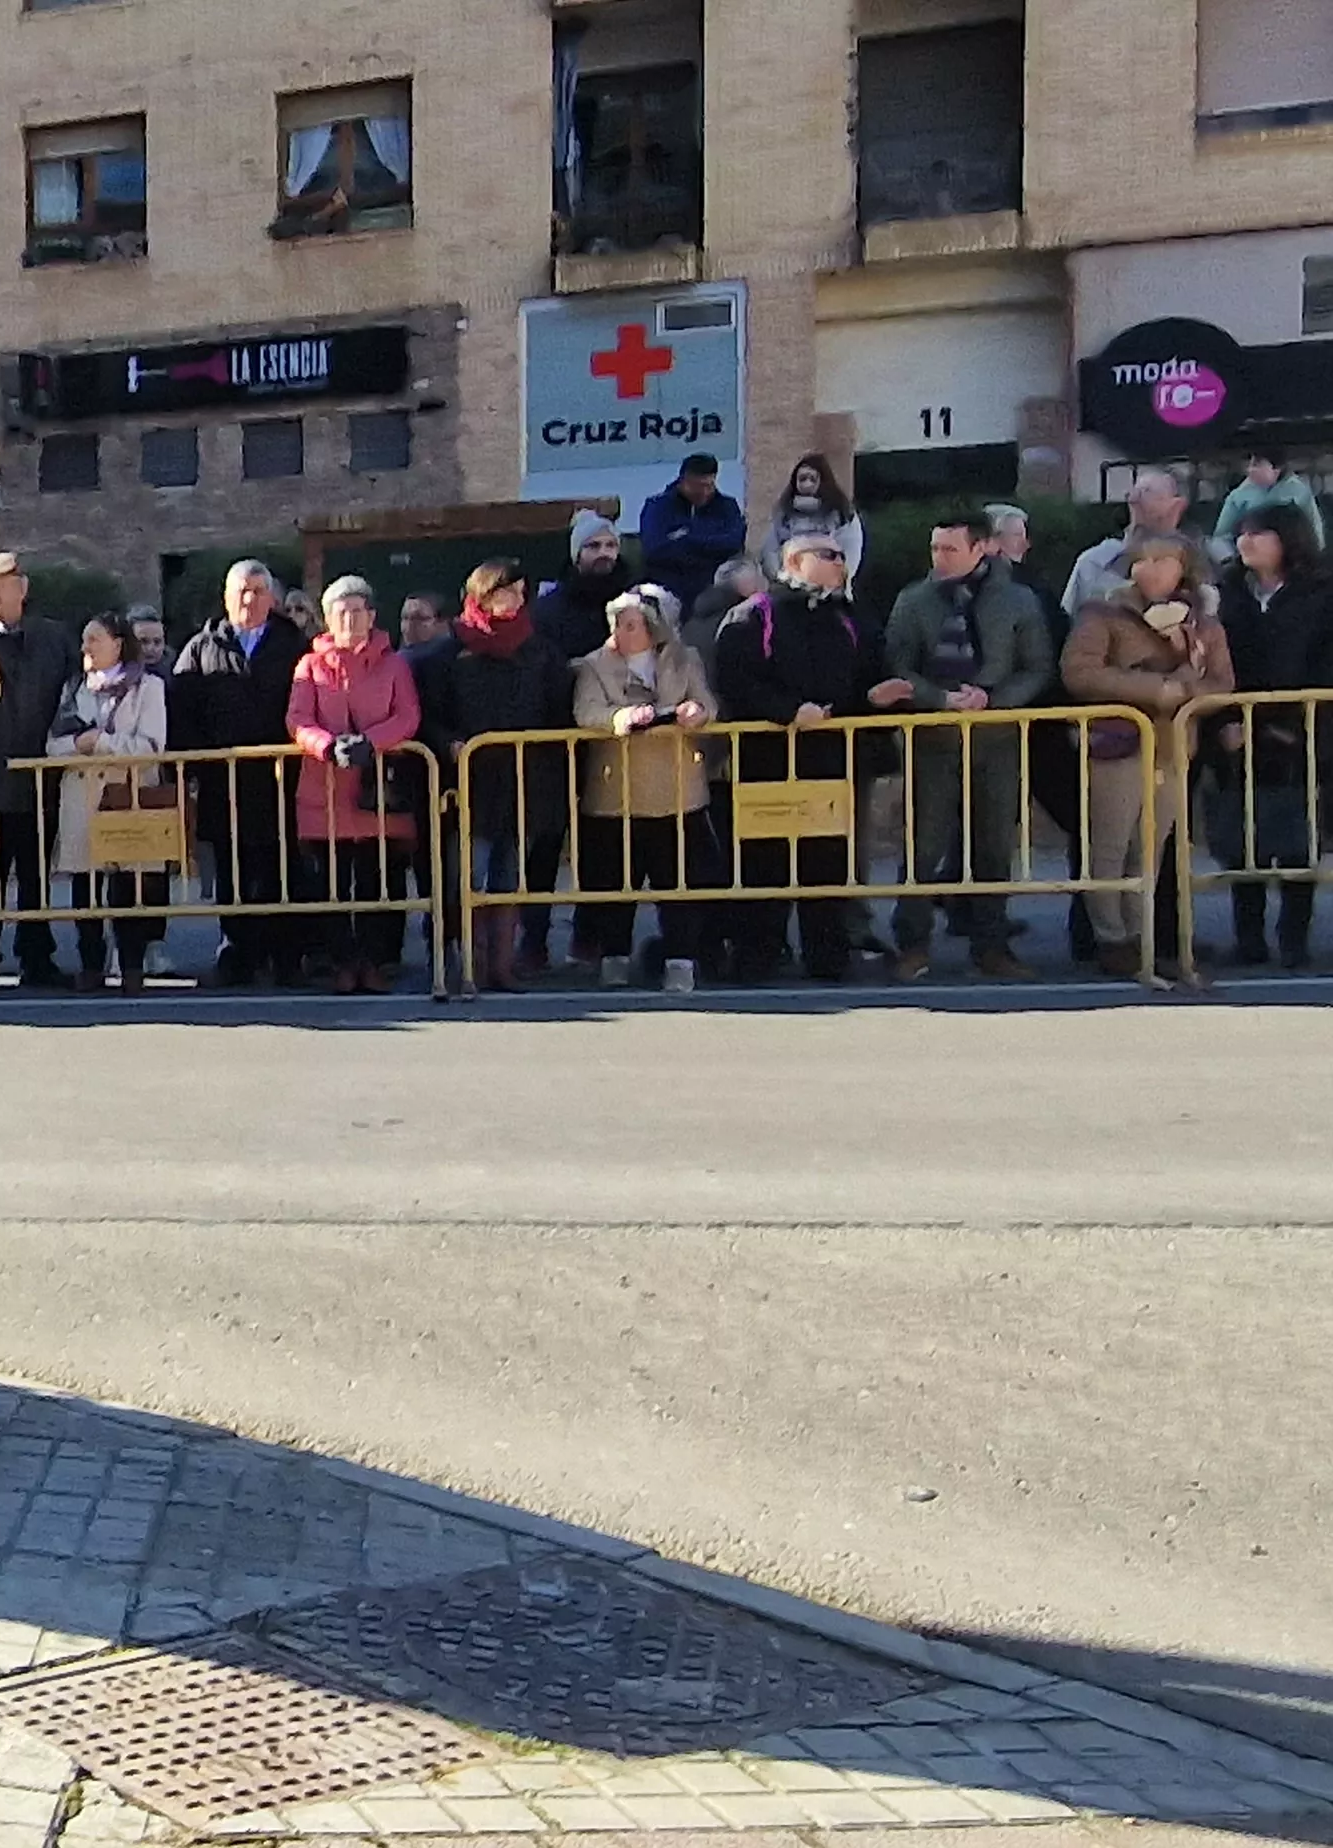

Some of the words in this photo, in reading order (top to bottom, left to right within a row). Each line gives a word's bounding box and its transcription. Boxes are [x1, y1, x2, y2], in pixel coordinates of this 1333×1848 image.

[232, 347, 251, 385] LA
[260, 340, 330, 381] ESENCIA
[1111, 355, 1199, 384] moda
[541, 417, 627, 445] Cruz
[639, 407, 723, 442] Roja
[920, 406, 952, 438] 11
